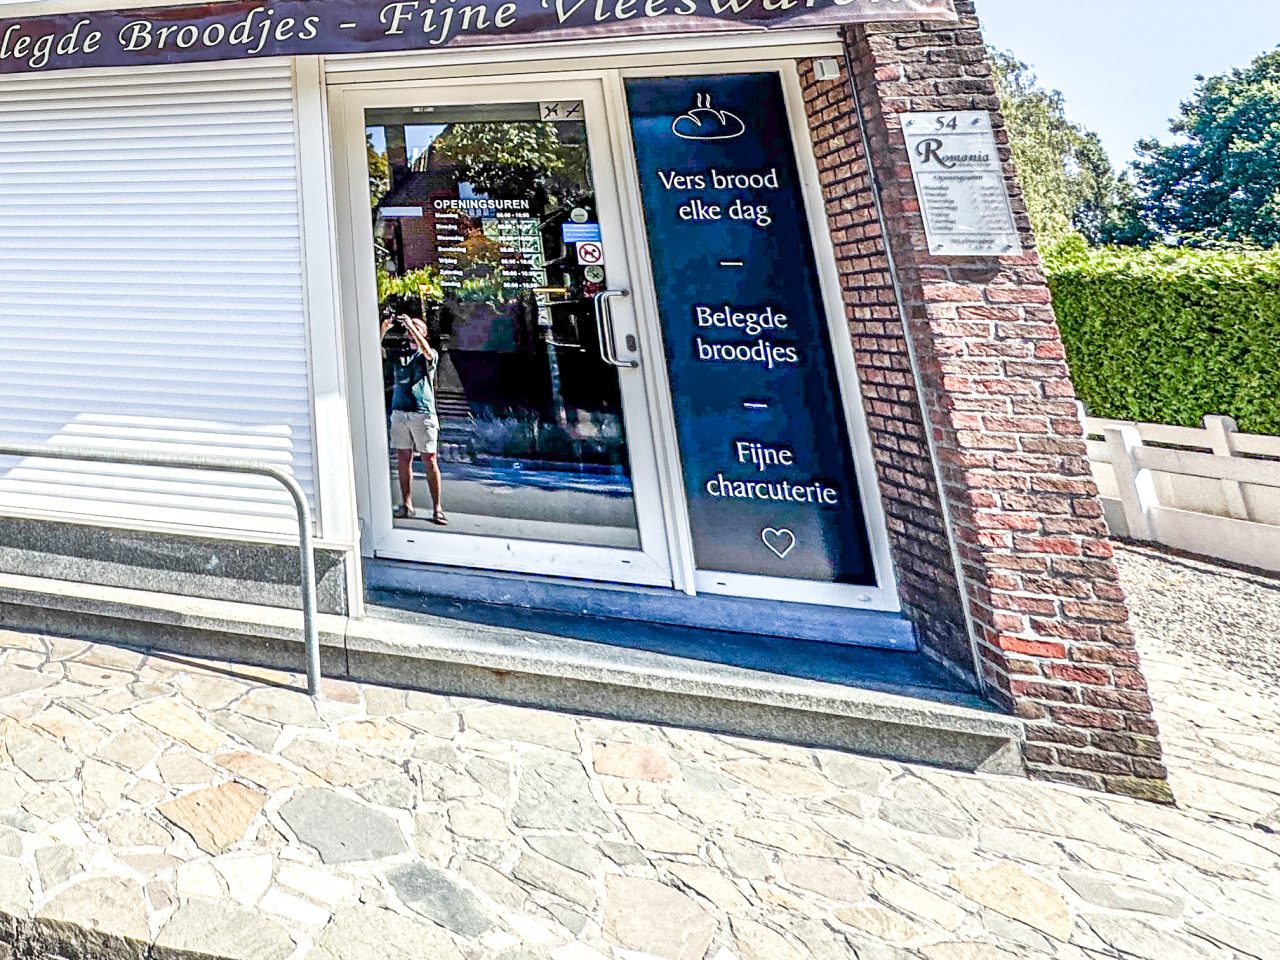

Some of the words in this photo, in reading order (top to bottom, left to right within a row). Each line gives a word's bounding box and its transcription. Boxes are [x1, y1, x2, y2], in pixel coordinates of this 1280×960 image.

[118, 7, 320, 54] Broodjes
[934, 115, 958, 131] 54
[658, 171, 706, 190] Vers
[711, 168, 779, 189] brood
[434, 200, 529, 209] OPENINGSUREN
[679, 200, 721, 220] elke
[728, 200, 771, 226] dag
[696, 306, 788, 335] Belegde
[697, 338, 798, 368] broodjes
[735, 441, 793, 471] Fijne
[706, 474, 838, 504] charcuterie
